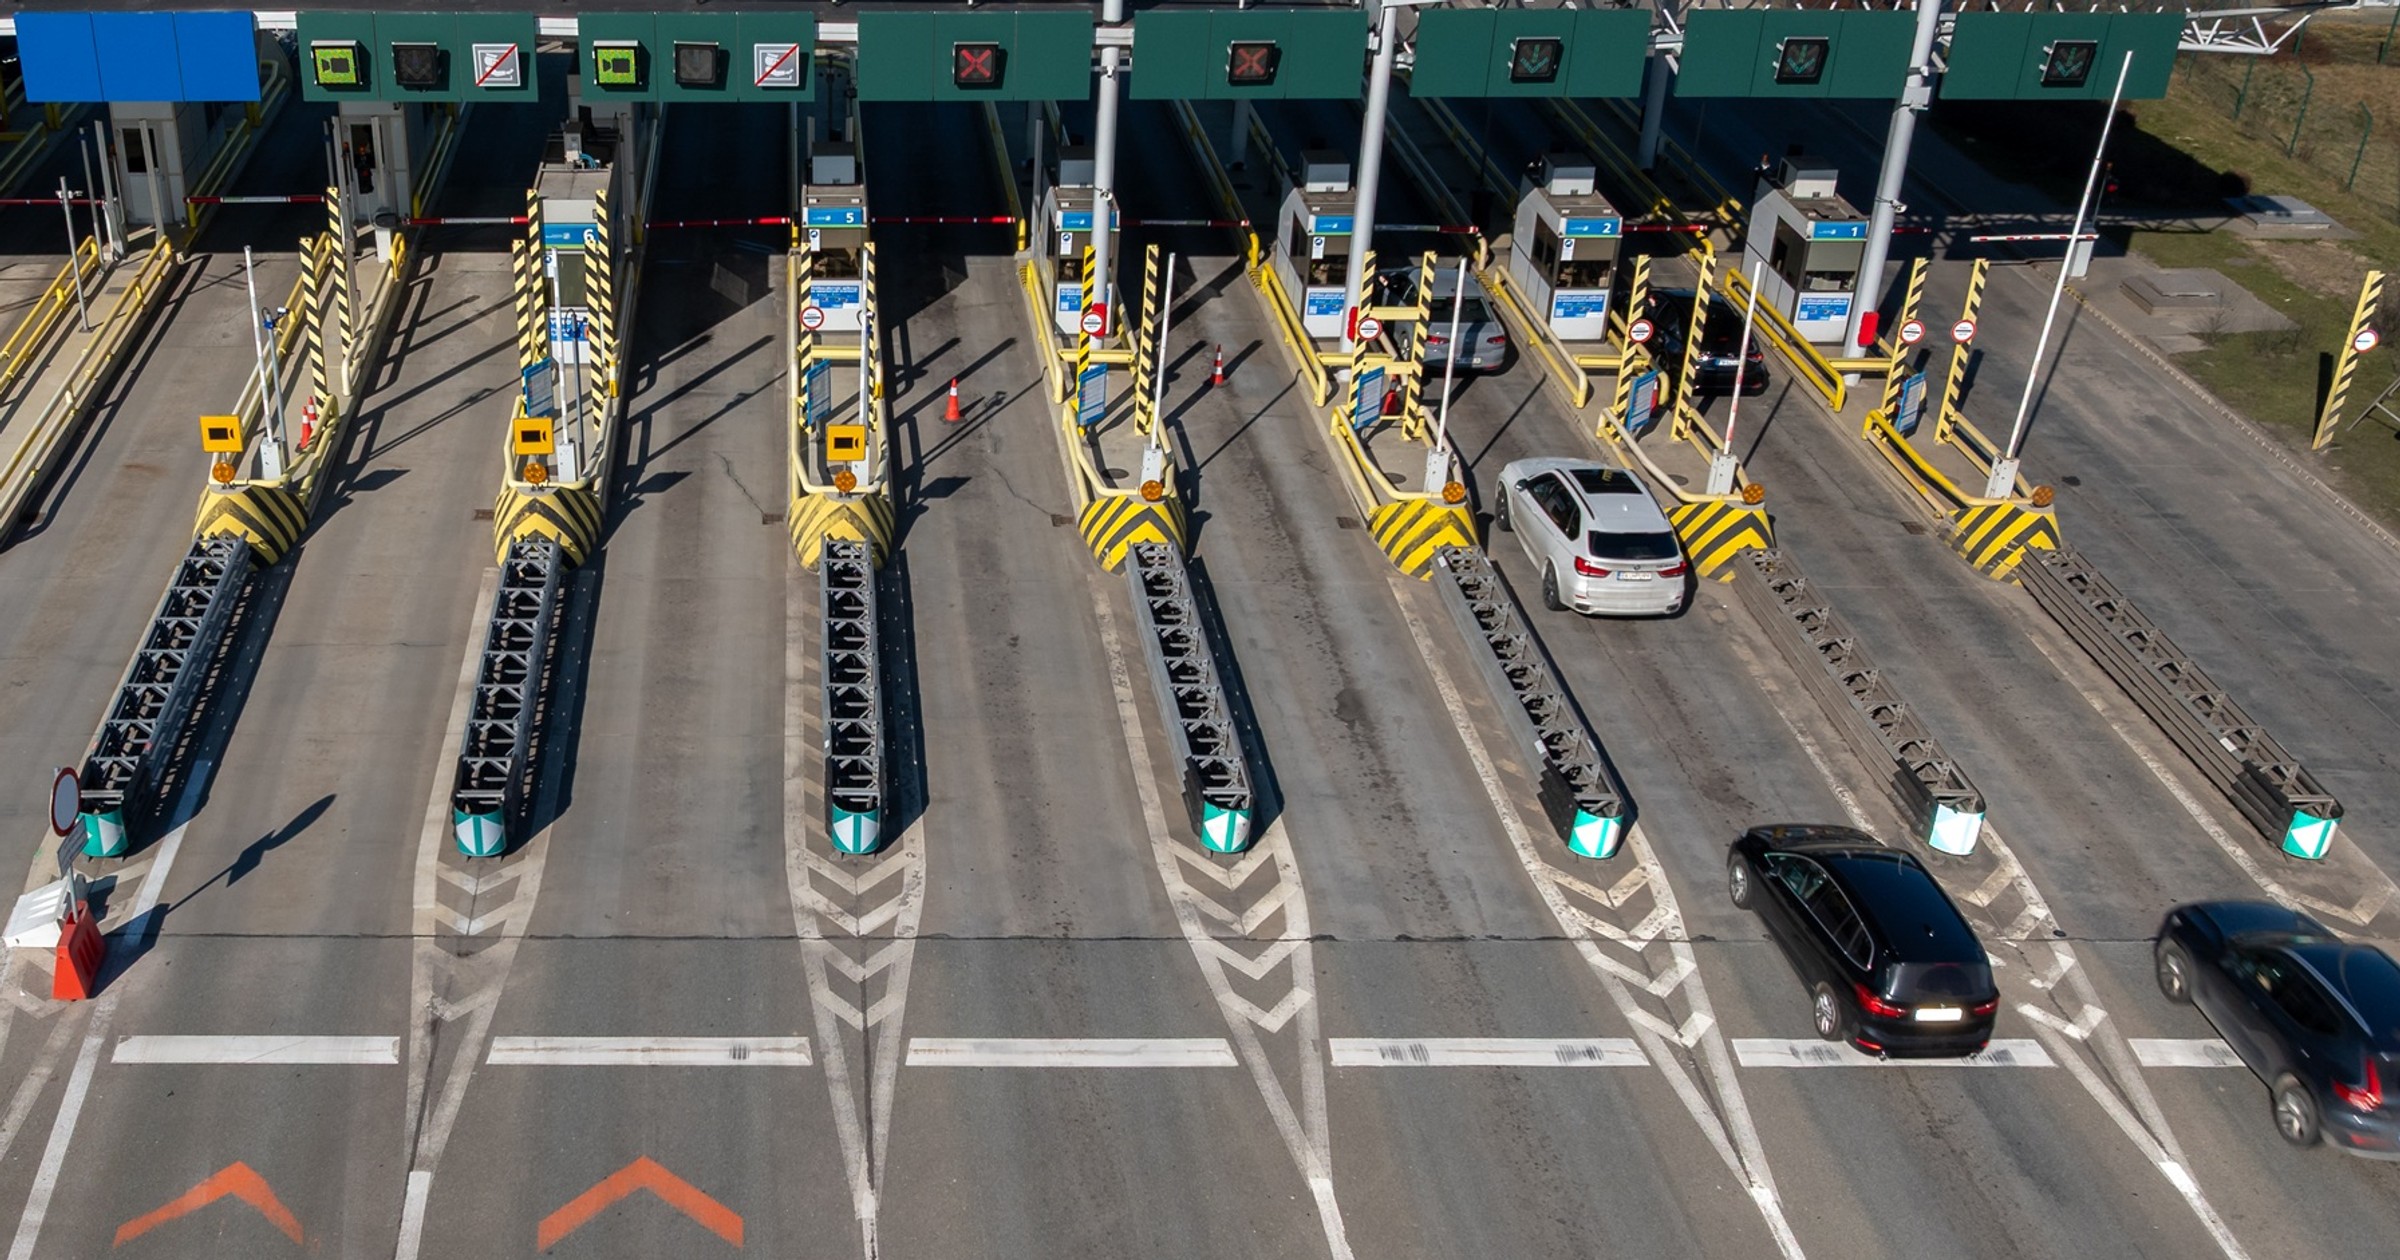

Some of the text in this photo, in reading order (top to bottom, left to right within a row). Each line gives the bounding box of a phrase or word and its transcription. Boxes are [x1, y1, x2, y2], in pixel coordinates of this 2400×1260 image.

[846, 212, 854, 223] 5
[1602, 223, 1612, 234] 2
[1851, 227, 1858, 237] 1
[583, 229, 596, 242] 6
